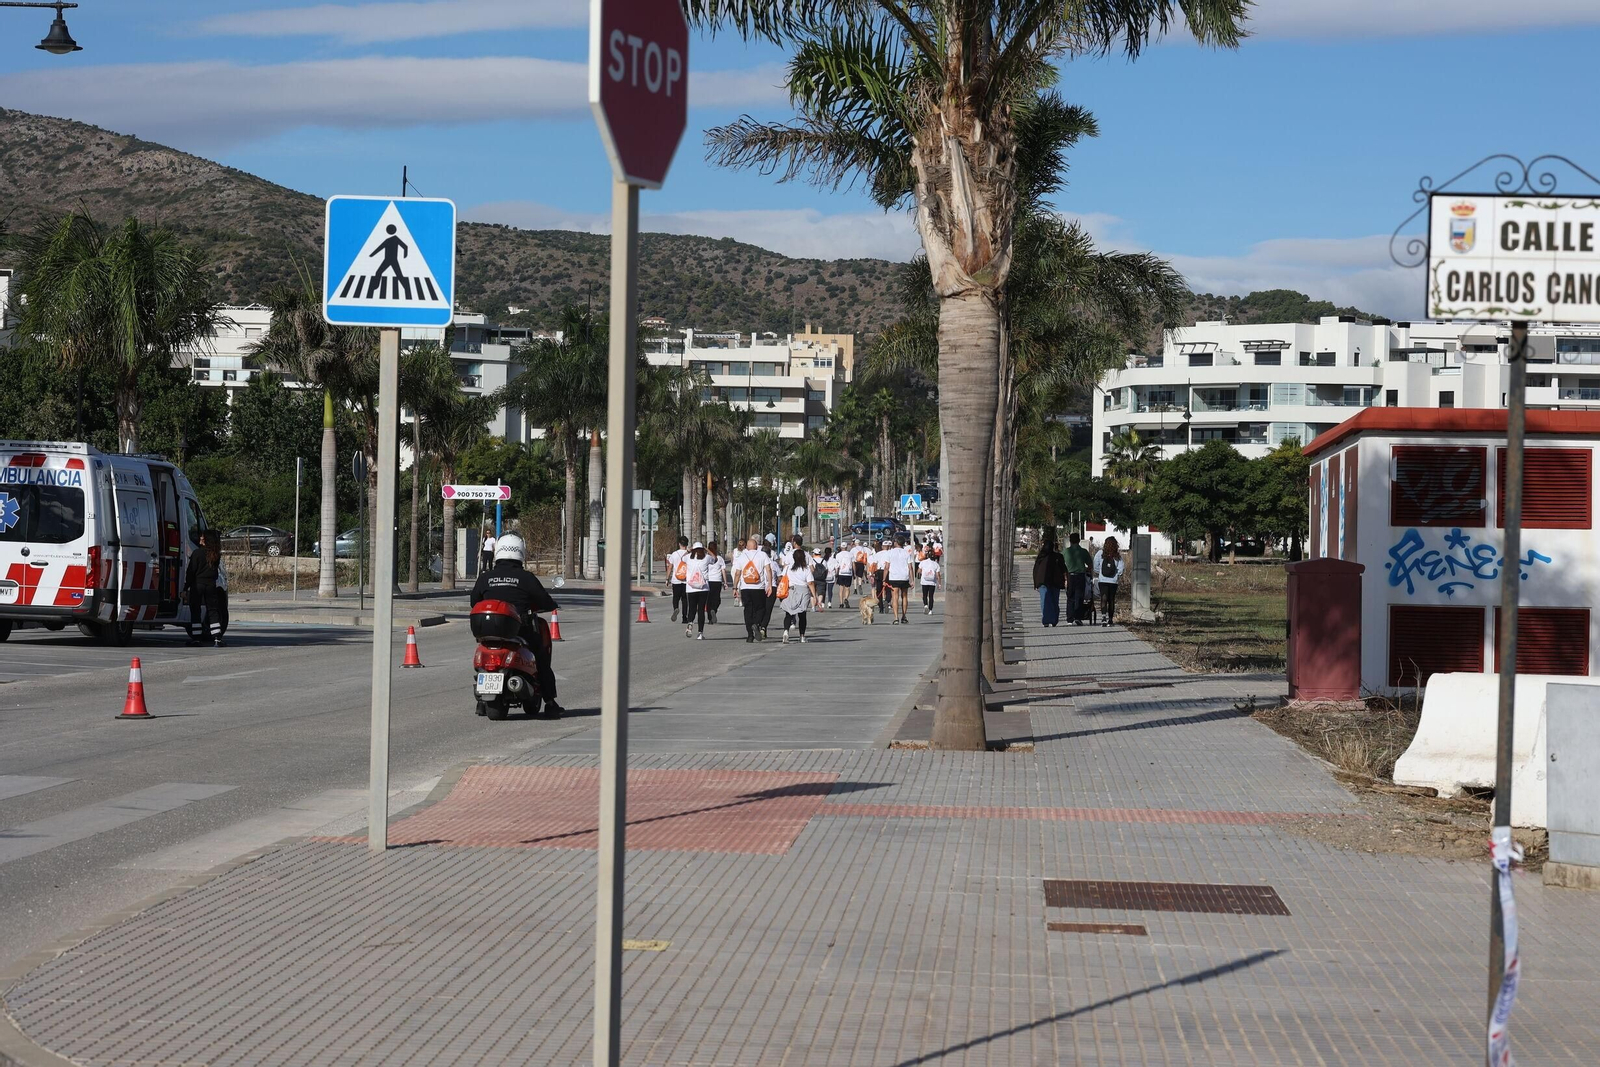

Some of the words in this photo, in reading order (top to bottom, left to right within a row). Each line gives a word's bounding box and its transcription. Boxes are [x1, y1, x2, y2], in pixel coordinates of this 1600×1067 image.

[608, 29, 682, 97] STOP
[1500, 220, 1594, 252] CALLE
[1446, 270, 1536, 304] CARLOS
[484, 674, 503, 682] 1930
[484, 682, 500, 691] GRJ
